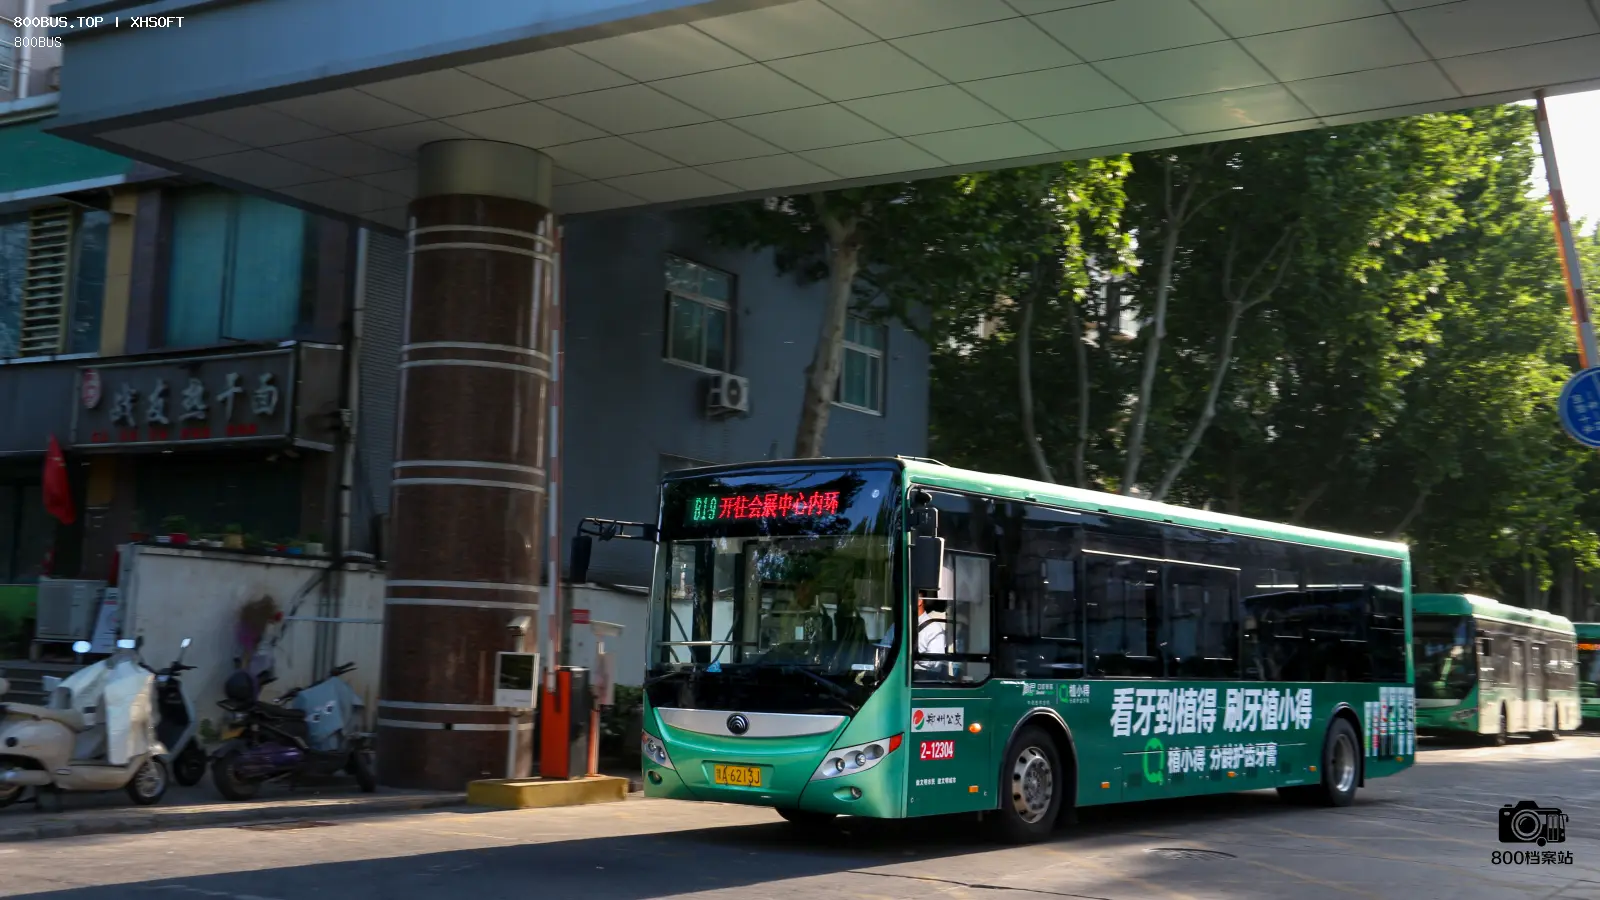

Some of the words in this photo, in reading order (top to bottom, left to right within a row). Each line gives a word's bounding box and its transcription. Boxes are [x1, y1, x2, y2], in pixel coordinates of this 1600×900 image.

[718, 491, 840, 519] 开往会展中心内环
[1110, 688, 1217, 737] 看牙到植得
[1223, 688, 1313, 733] 刷牙植小得
[920, 741, 954, 759] 2-12304
[1167, 746, 1206, 773] 植小得
